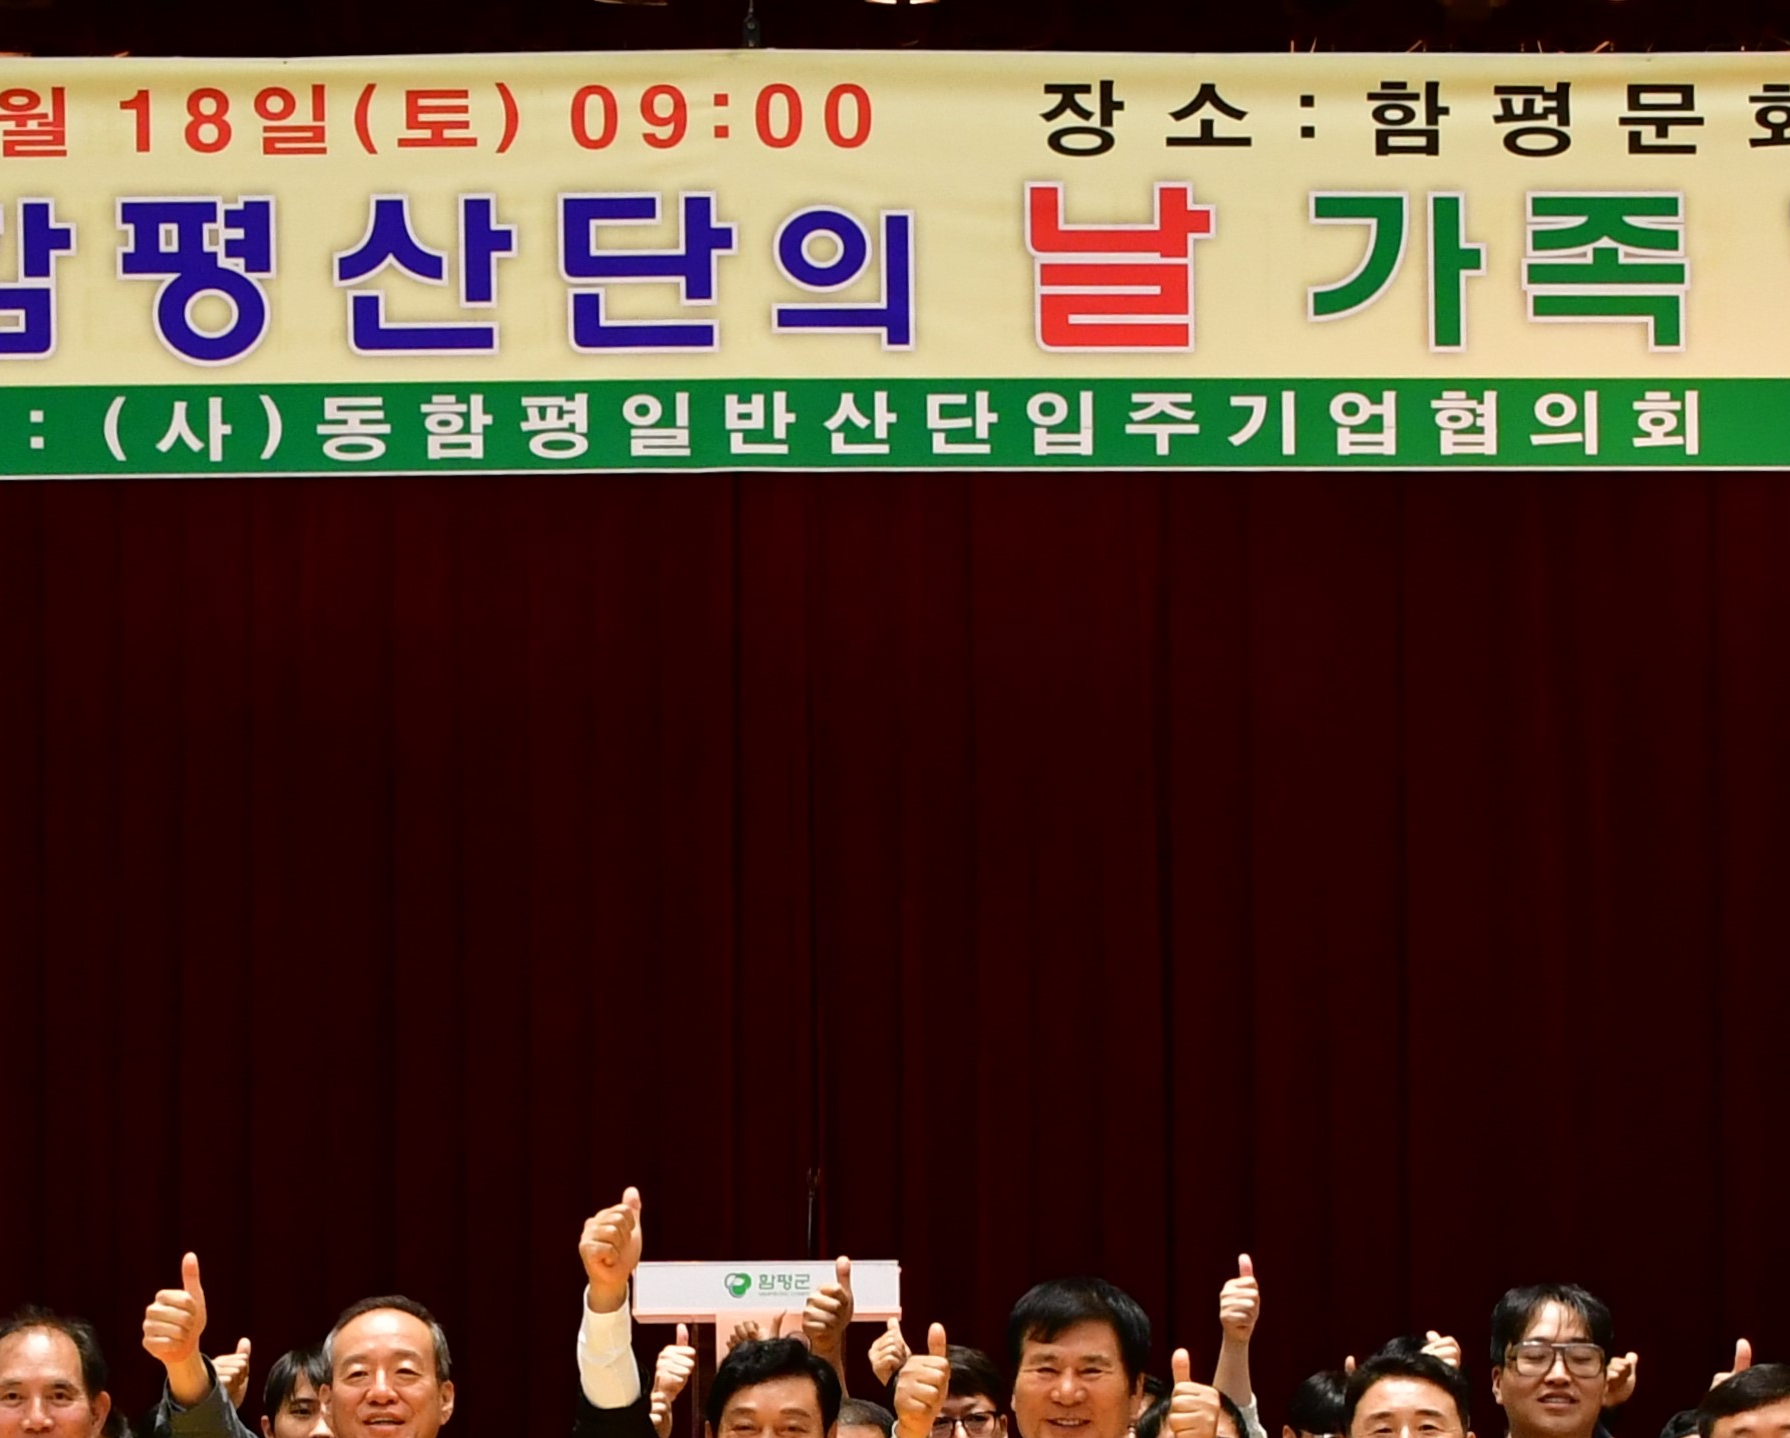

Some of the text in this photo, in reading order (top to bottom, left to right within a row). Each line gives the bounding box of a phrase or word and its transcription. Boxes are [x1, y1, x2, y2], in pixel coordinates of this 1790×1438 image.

[120, 82, 518, 155] 18일(토)
[571, 83, 871, 149] 09:00
[1027, 184, 1211, 350] 날
[1309, 189, 1691, 348] 가족
[759, 1274, 810, 1291] 함평군
